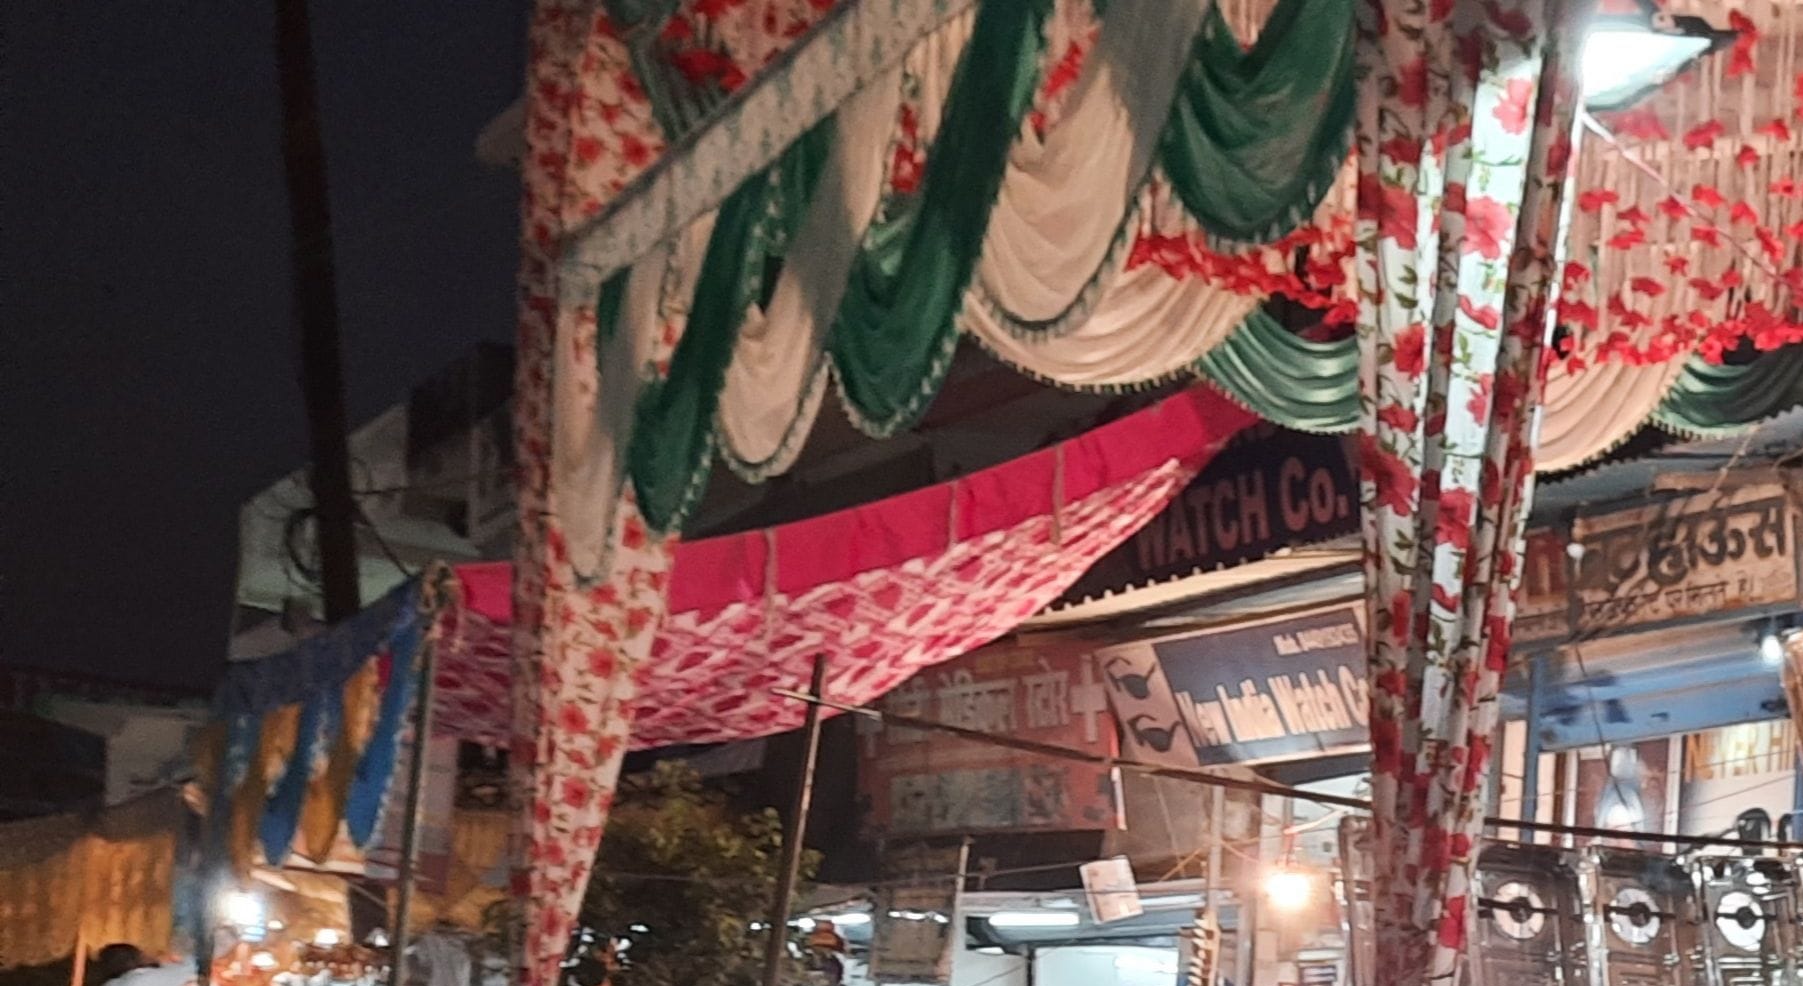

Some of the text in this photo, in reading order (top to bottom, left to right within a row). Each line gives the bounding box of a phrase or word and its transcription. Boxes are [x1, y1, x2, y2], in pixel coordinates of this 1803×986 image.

[1136, 456, 1350, 572] WATCH Co.
[1216, 678, 1287, 743] India
[1268, 669, 1353, 736] Watch
